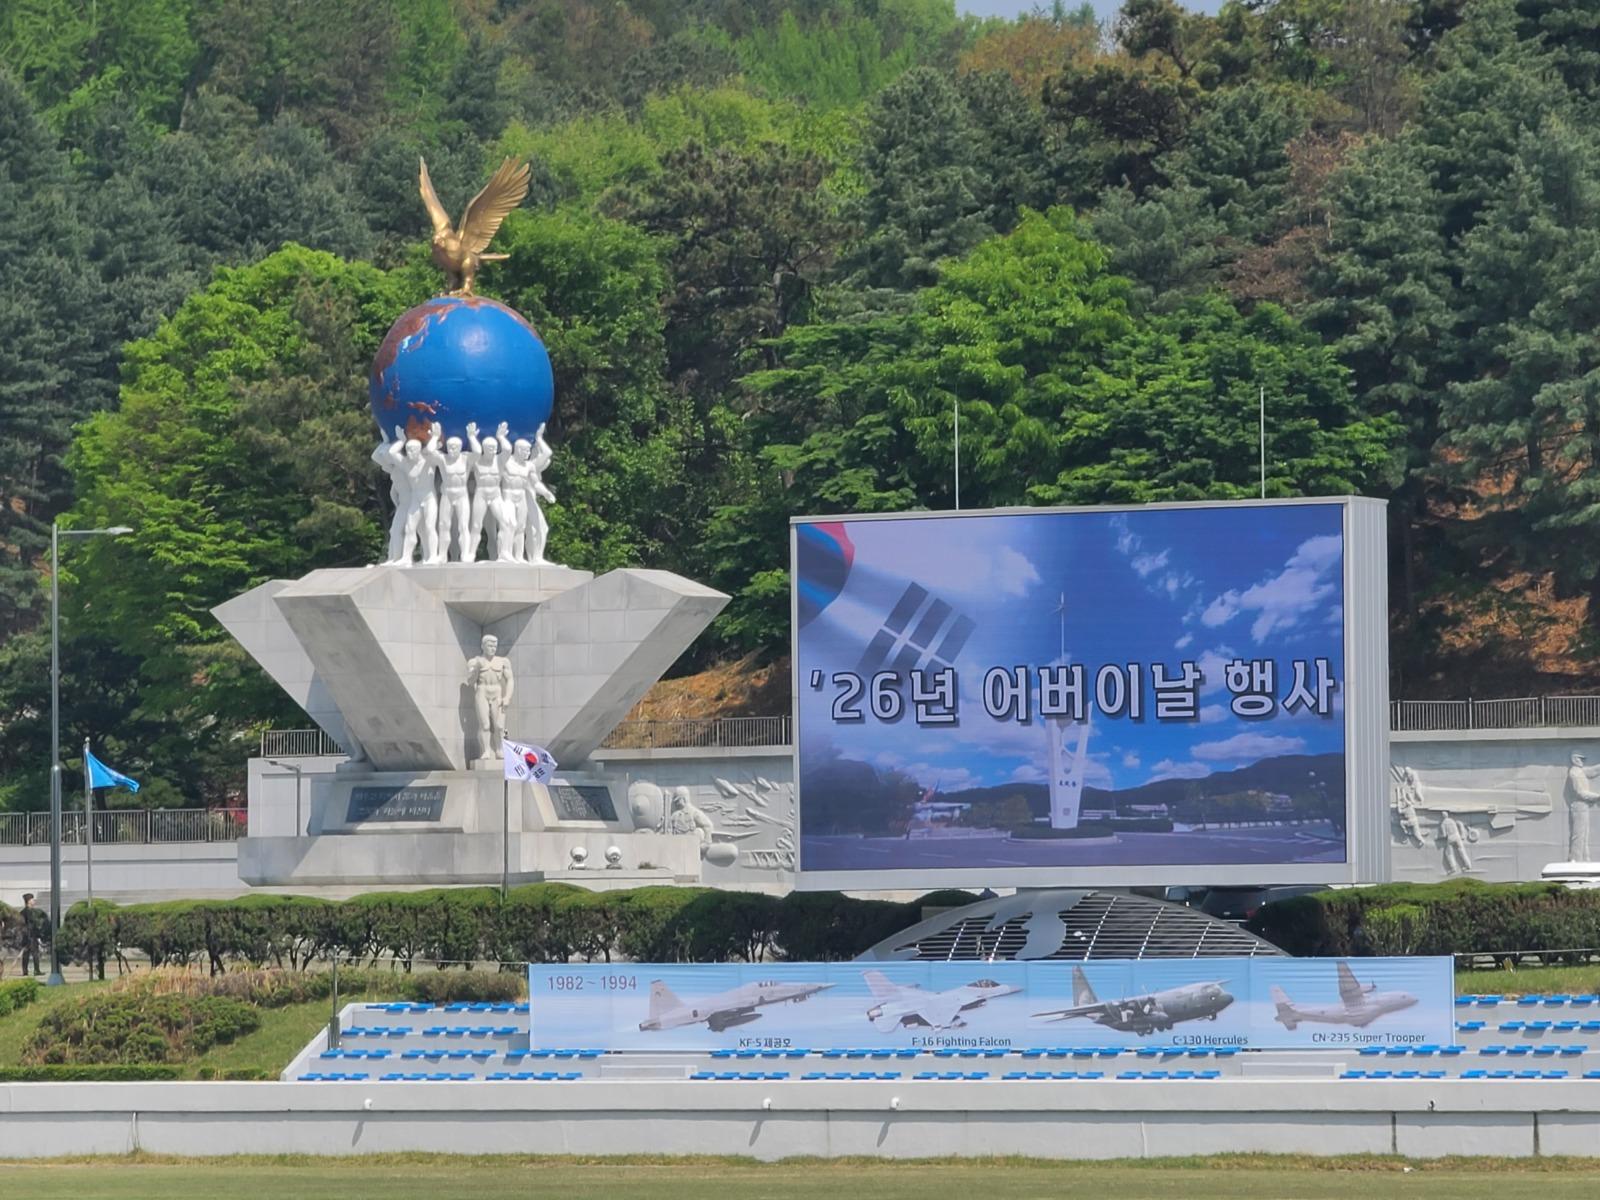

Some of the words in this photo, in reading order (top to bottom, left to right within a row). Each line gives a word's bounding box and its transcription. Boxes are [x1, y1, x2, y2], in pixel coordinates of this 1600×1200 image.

[810, 668, 957, 724] '26년
[983, 661, 1202, 721] 어버이날
[1225, 658, 1336, 715] 행사
[739, 1038, 762, 1047] KF-5
[912, 1037, 934, 1046] F-16
[936, 1037, 977, 1047] Fighting
[979, 1037, 1011, 1046] Falcon
[1172, 1035, 1202, 1045] C-130
[1204, 1034, 1248, 1045] Hercules
[1312, 1033, 1350, 1042] CN-235
[1353, 1033, 1382, 1043] Super
[1385, 1033, 1425, 1043] Trooper
